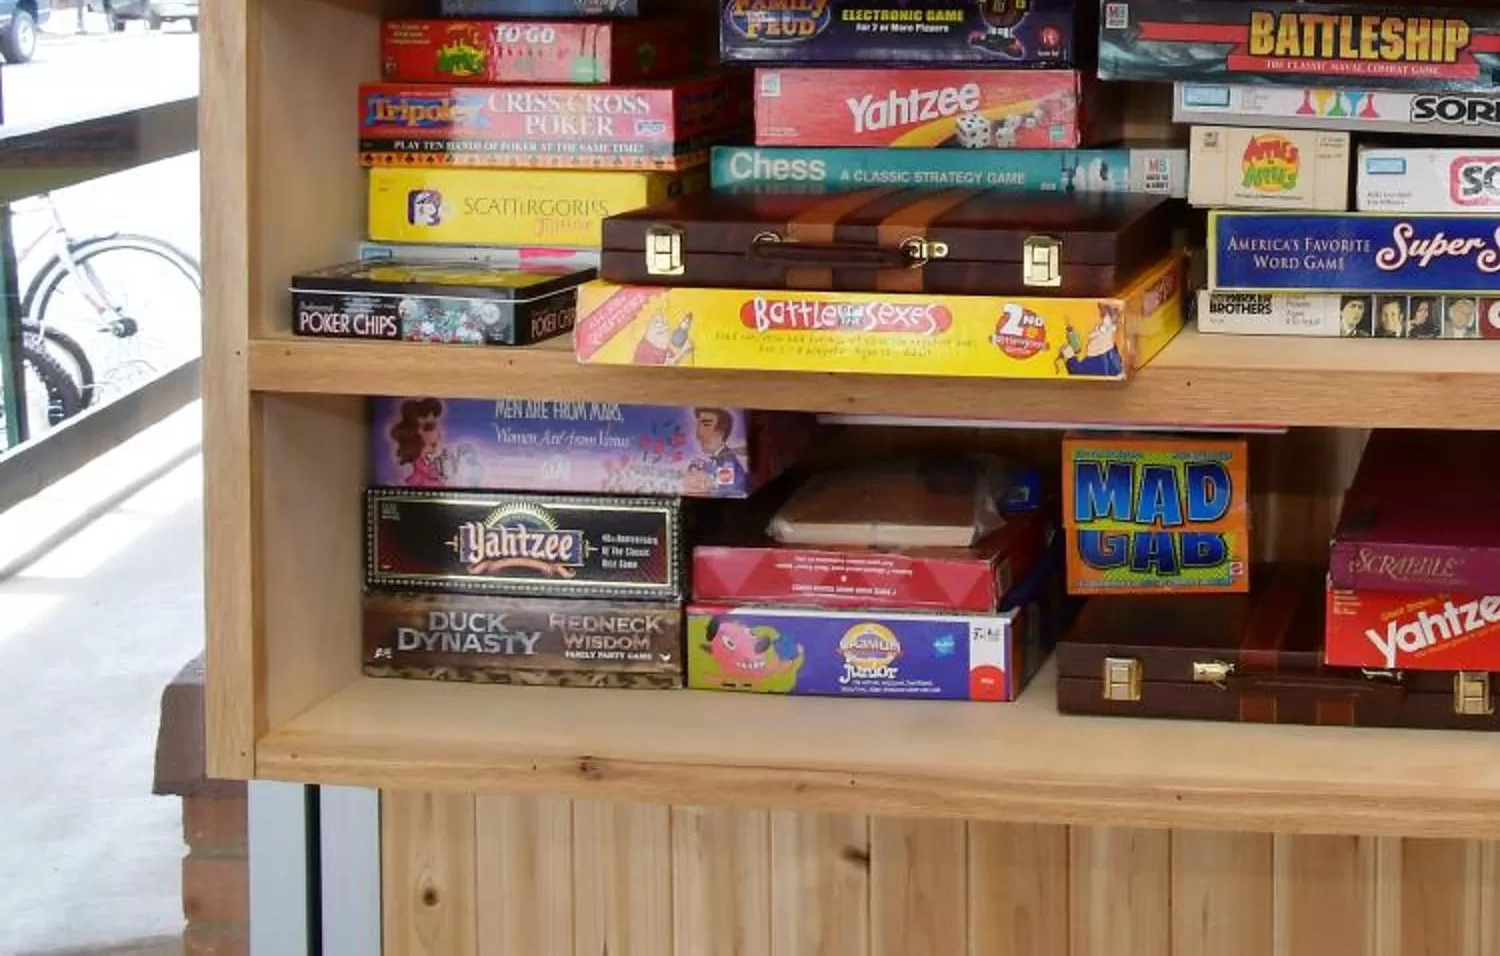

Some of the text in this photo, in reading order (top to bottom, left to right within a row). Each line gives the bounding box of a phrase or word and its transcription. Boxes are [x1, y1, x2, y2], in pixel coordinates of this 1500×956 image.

[744, 14, 816, 38] FEUD
[842, 9, 963, 22] ELECTRONIC GAME
[1250, 11, 1471, 62] BATTLESHIP
[567, 92, 651, 115] CROSS
[845, 81, 982, 133] Yahtzee
[525, 114, 614, 138] POKER
[729, 150, 1025, 185] Chess A CLASSIC STRATEGY GAME
[1227, 236, 1371, 253] AMERICA'S FAVORITE
[1376, 222, 1487, 271] Super
[1253, 254, 1346, 271] WORD GAME
[1209, 301, 1273, 315] BROTHERS
[300, 311, 397, 337] POKER CHIPS
[1073, 458, 1234, 528] MAD
[465, 521, 575, 565] Yahtzee
[1077, 528, 1231, 576] GAB
[429, 611, 665, 634] DUCK REDNECK
[397, 627, 652, 657] DYNASTY WISDOM
